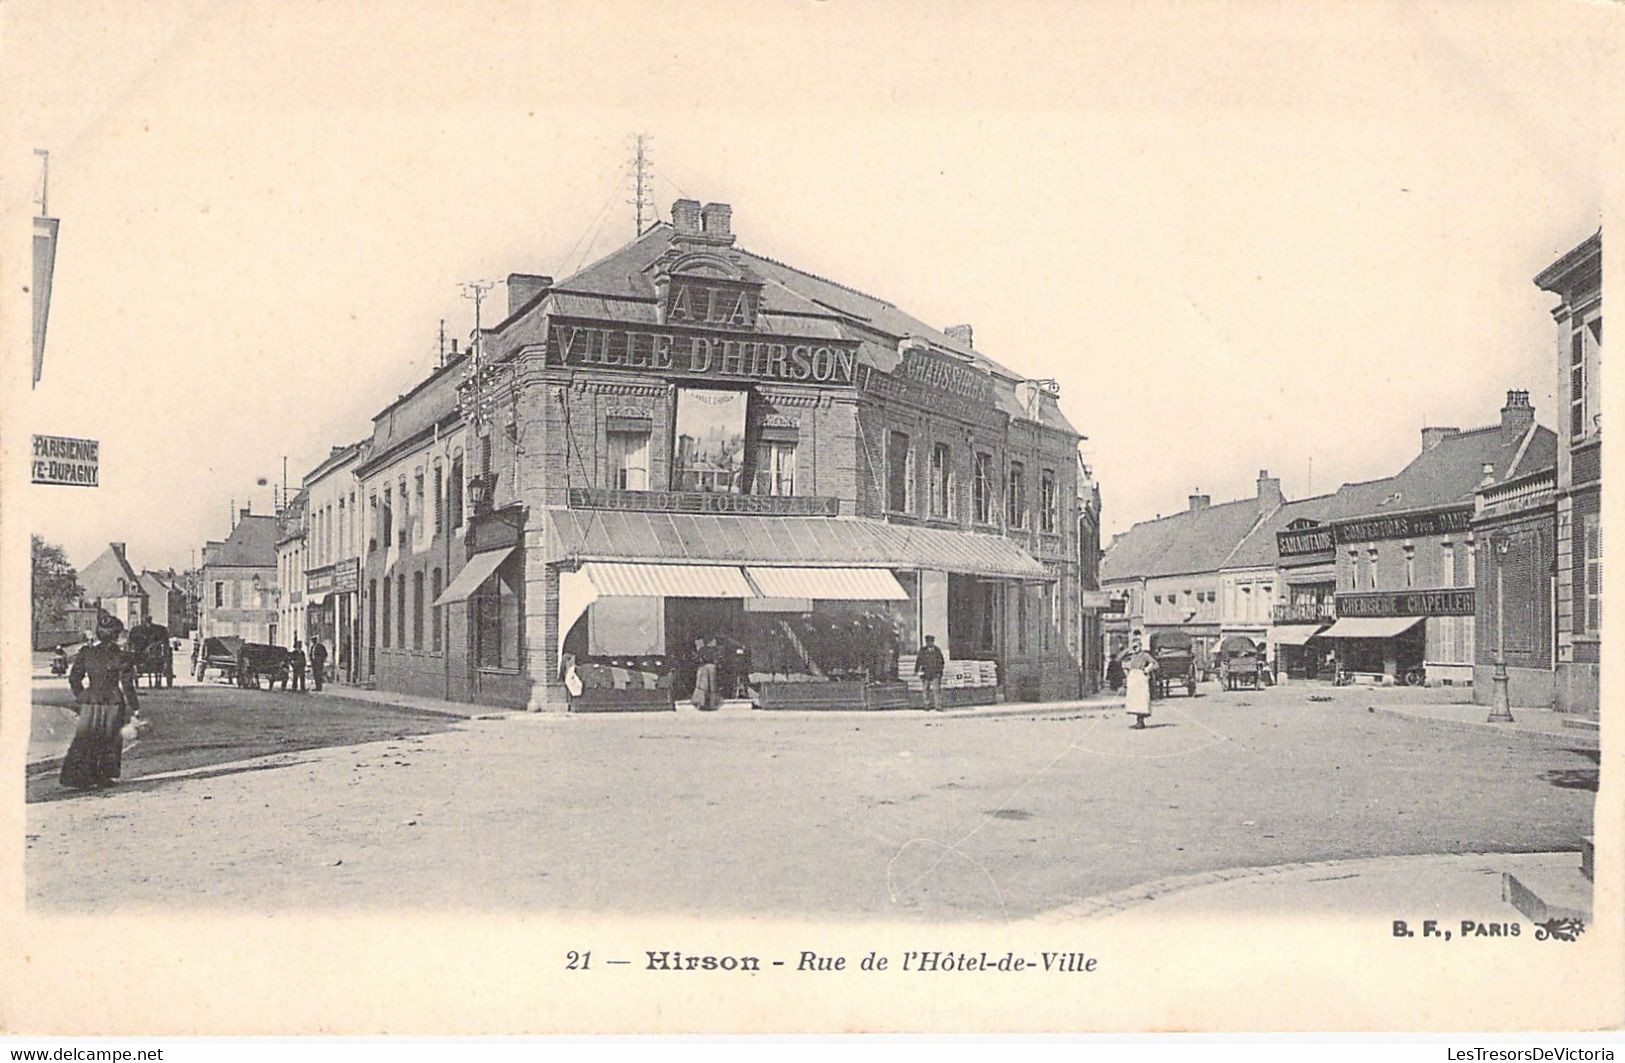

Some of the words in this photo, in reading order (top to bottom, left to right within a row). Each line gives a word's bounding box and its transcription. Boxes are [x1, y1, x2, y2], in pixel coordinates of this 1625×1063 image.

[668, 284, 696, 321] A
[702, 287, 753, 326] LA
[551, 324, 674, 370] VILLE
[689, 336, 855, 382] D'HIRSON
